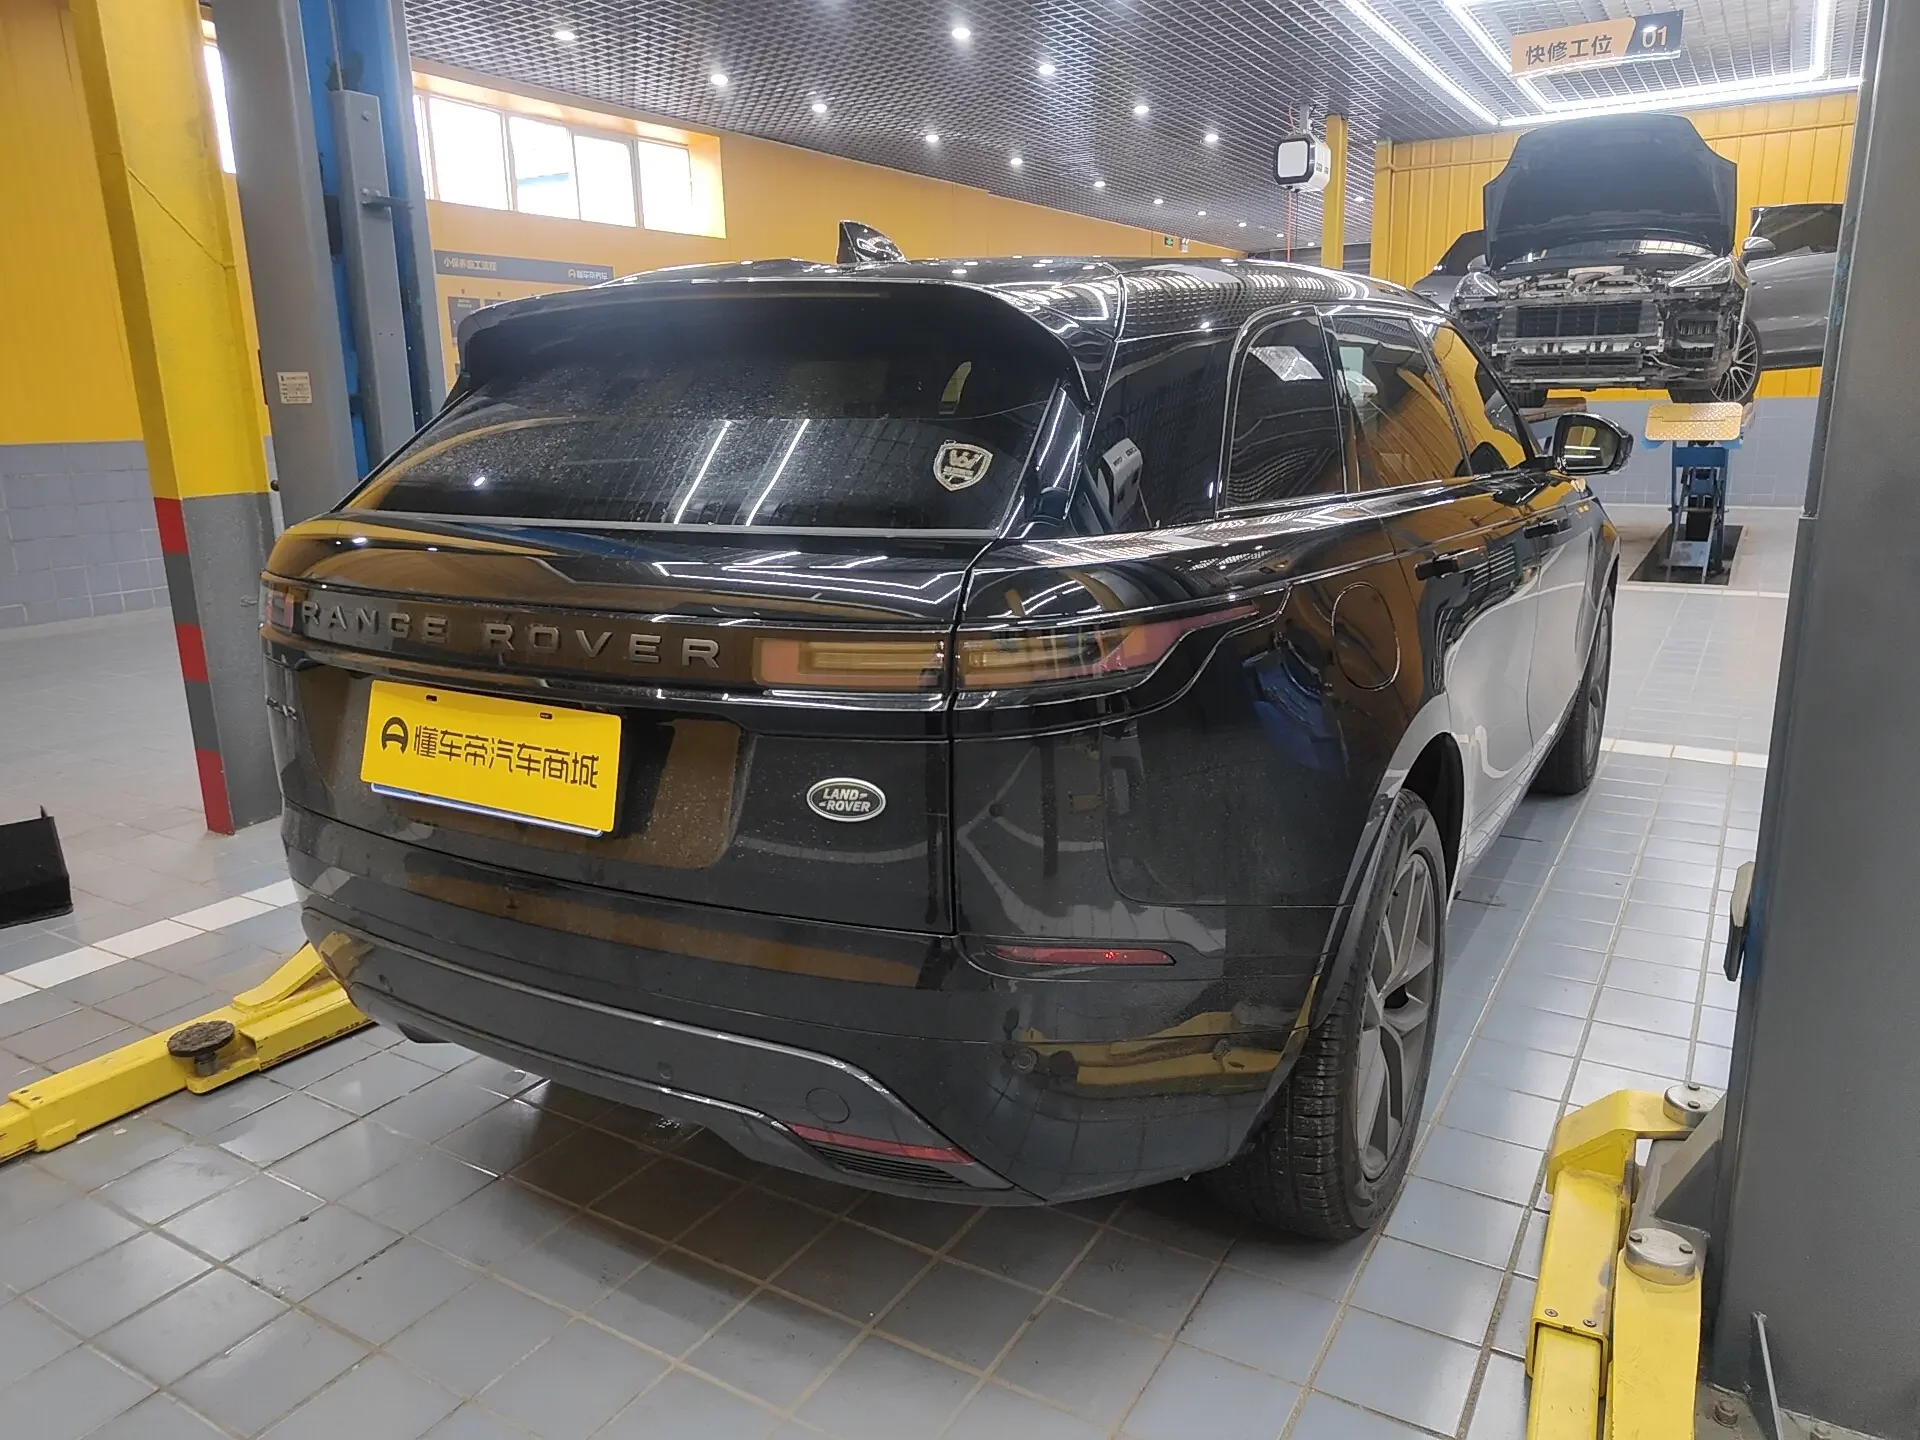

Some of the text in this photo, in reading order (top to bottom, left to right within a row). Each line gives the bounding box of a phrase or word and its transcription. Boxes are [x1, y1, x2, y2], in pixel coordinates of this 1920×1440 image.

[1525, 25, 1668, 65] 快修工位 01
[301, 600, 720, 669] RANGE ROVER
[413, 724, 600, 789] 懂车帝汽车商城
[823, 788, 859, 801] LAND
[826, 800, 871, 812] ROVER
